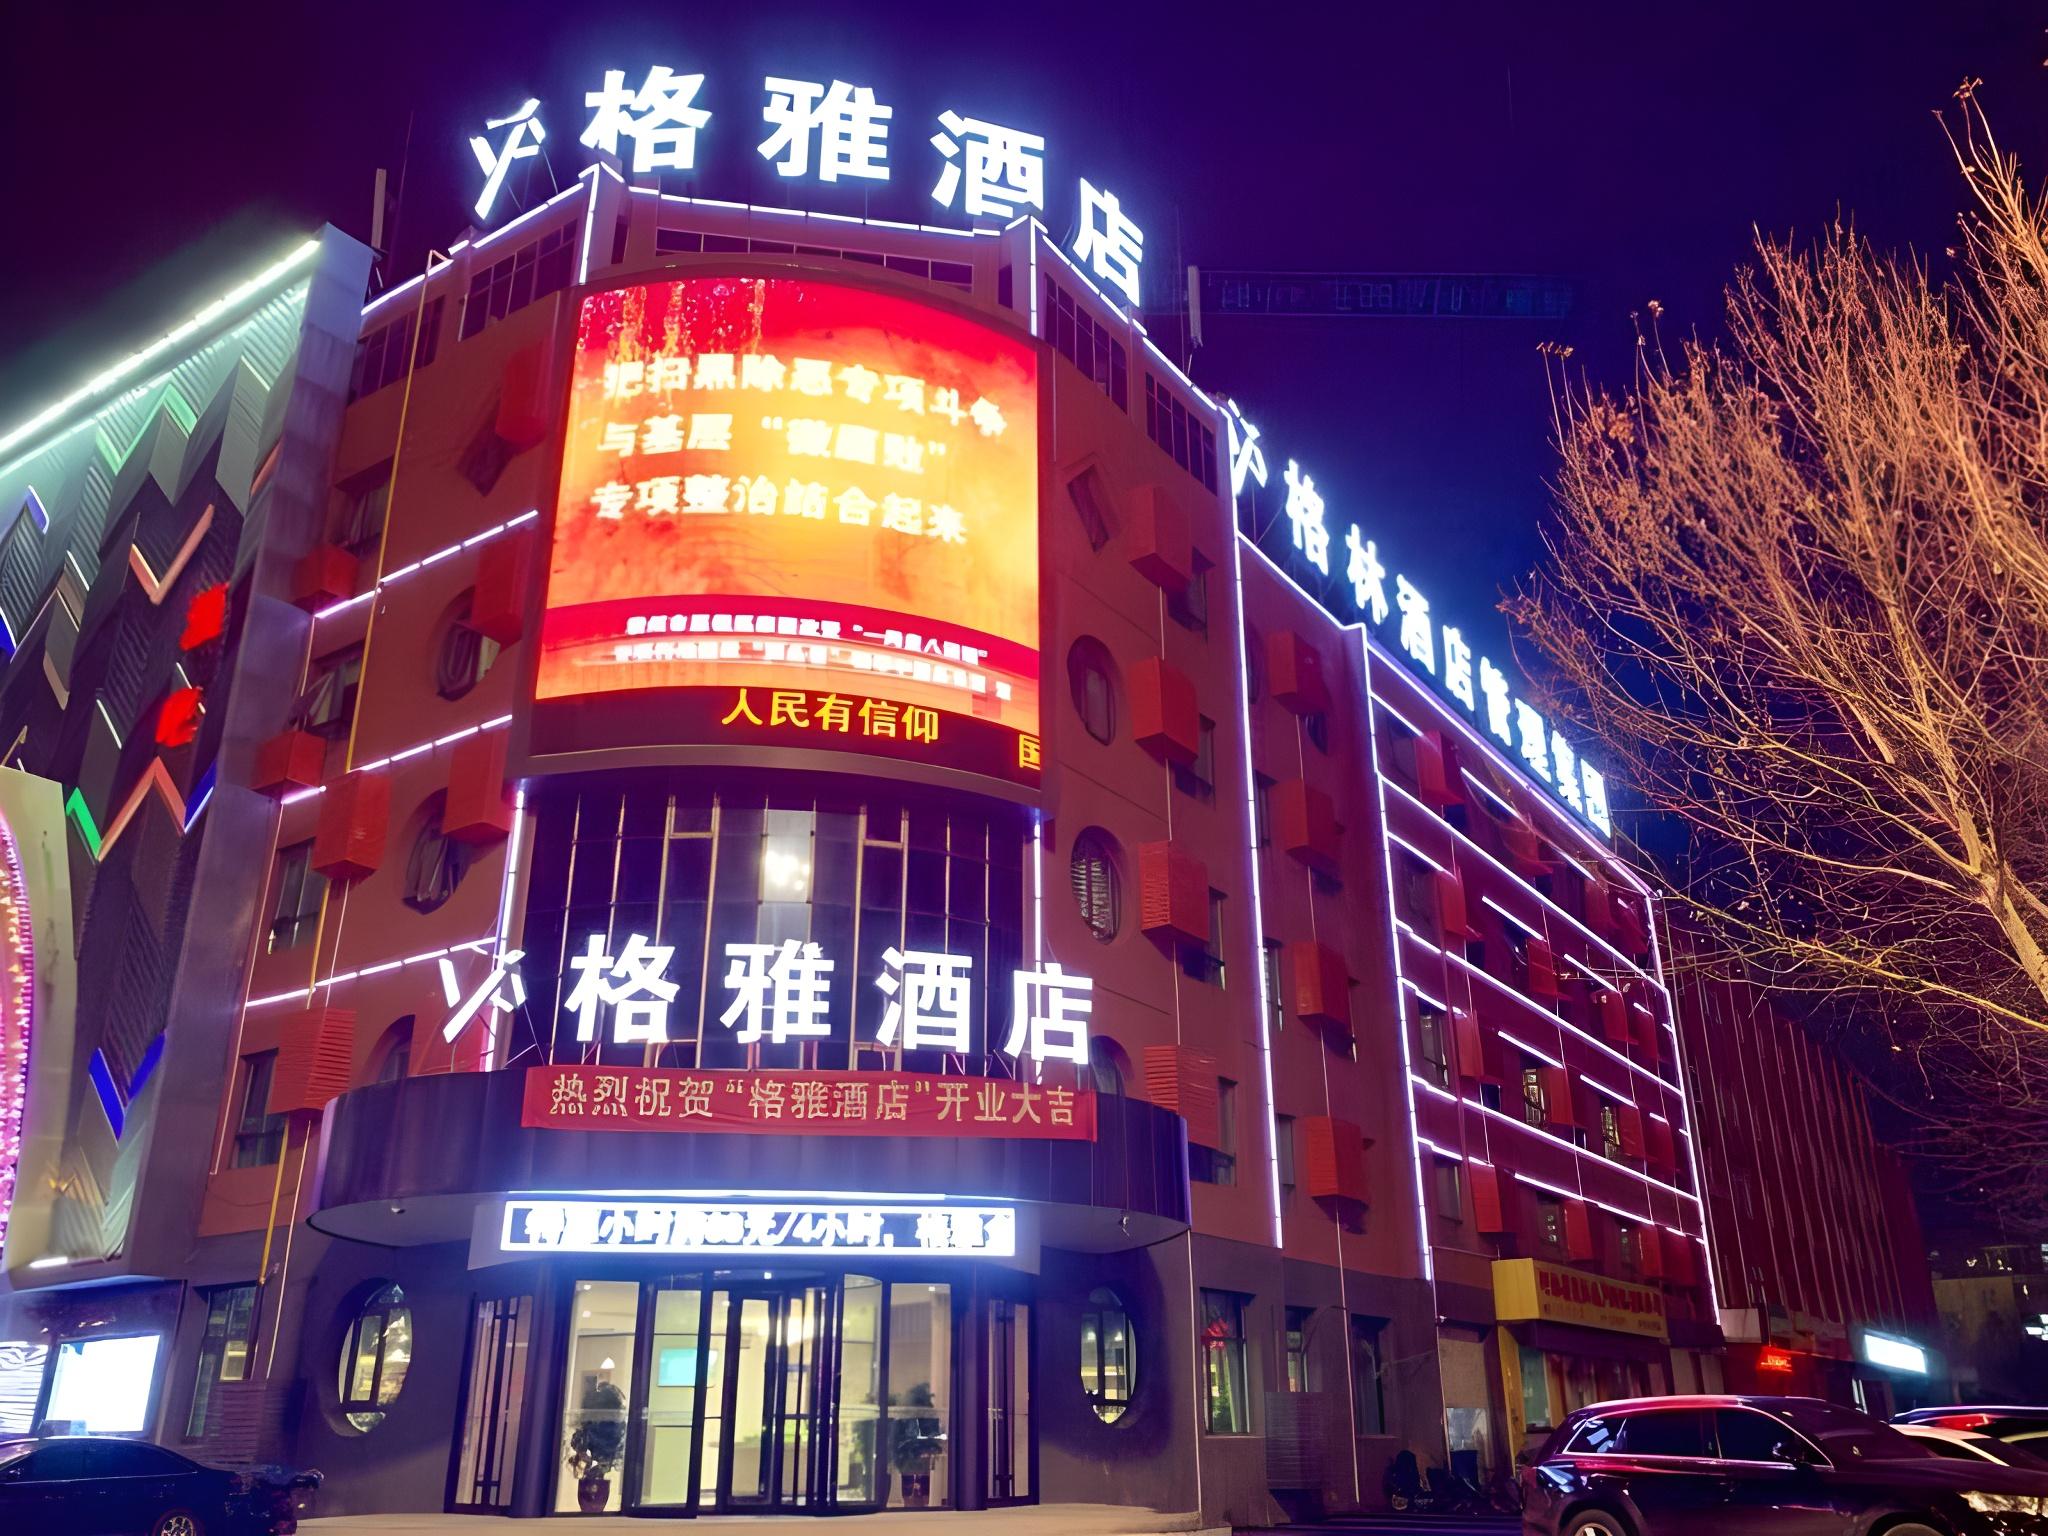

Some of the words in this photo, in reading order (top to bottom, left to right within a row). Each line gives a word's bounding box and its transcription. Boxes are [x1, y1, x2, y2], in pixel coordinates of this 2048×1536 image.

[578, 65, 1146, 308] 格雅酒店
[721, 689, 940, 744] 人民有信仰
[564, 933, 1094, 1065] 格雅酒店
